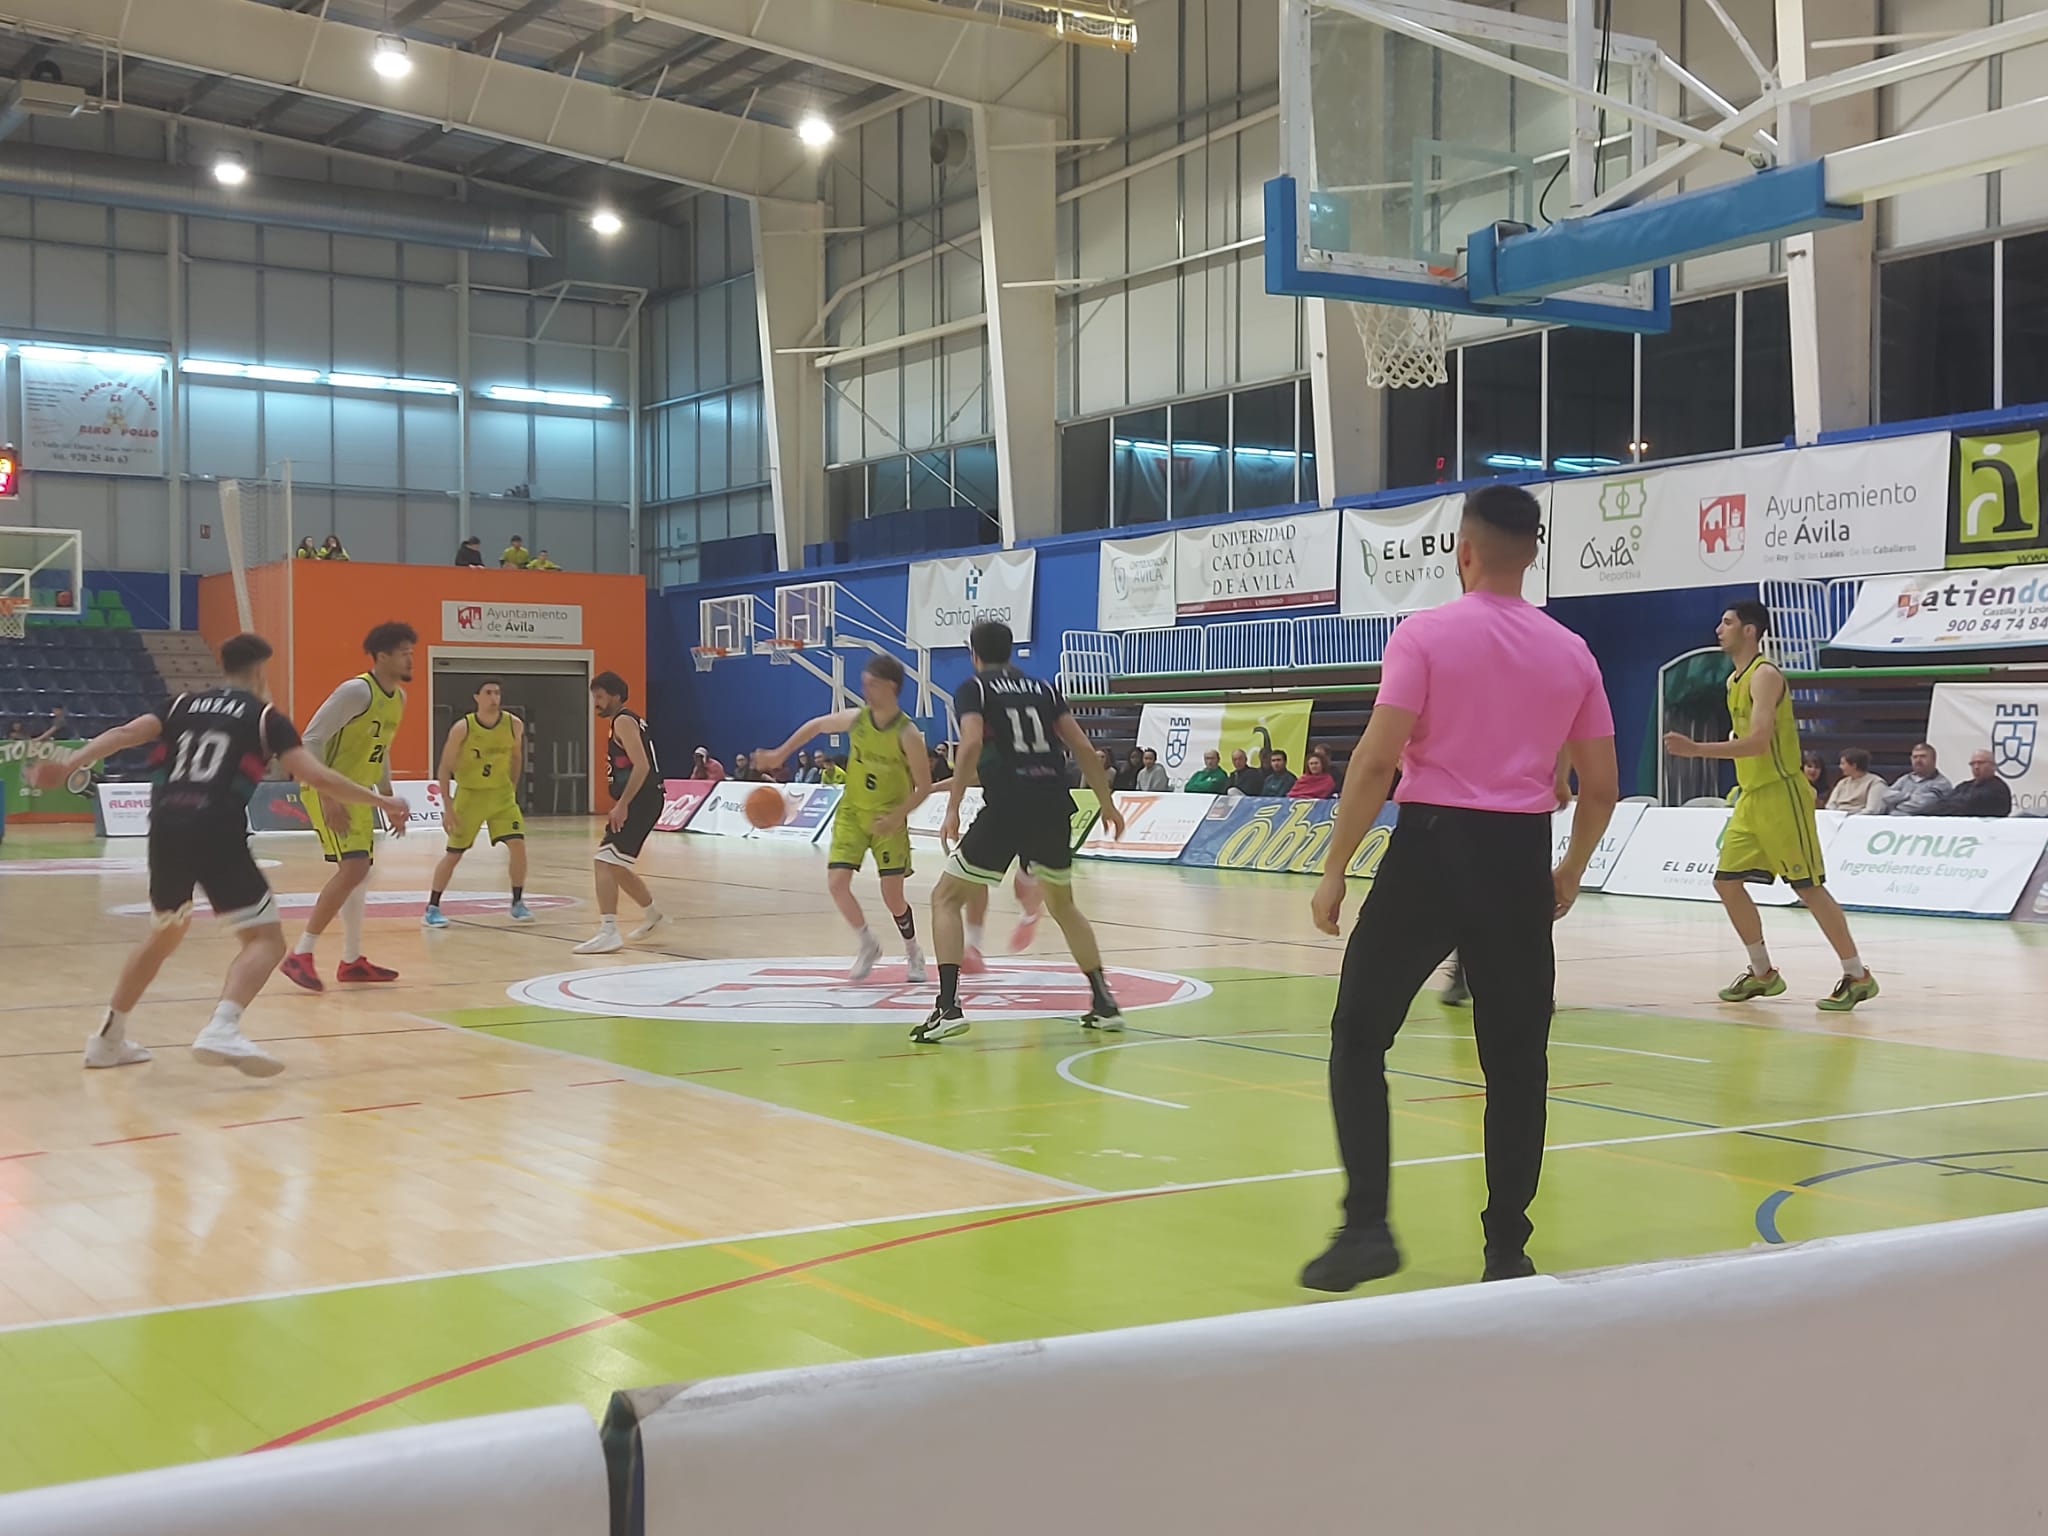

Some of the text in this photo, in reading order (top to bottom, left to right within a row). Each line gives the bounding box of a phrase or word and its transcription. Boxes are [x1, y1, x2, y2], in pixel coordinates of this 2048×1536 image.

[121, 427, 160, 438] POLLO
[1765, 482, 1917, 520] Ayuntamiento
[1212, 523, 1297, 549] UNIVERSIDAD
[1765, 516, 1851, 548] de Ávila
[1212, 547, 1297, 572] CATÓLICA
[1383, 541, 1410, 560] EL
[1580, 536, 1634, 569] Ávila
[1212, 572, 1296, 596] DE ÁVILA
[1384, 565, 1445, 584] CENTRO
[487, 607, 568, 620] Ayuntamiento
[1946, 618, 1977, 632] 900
[1980, 618, 2001, 632] 84
[2005, 617, 2025, 631] 74
[487, 619, 535, 633] de Ávila
[1005, 706, 1051, 754] 11
[168, 729, 231, 784] 10
[1662, 860, 1680, 872] EL
[1840, 858, 1989, 880] Ingredientes Europa
